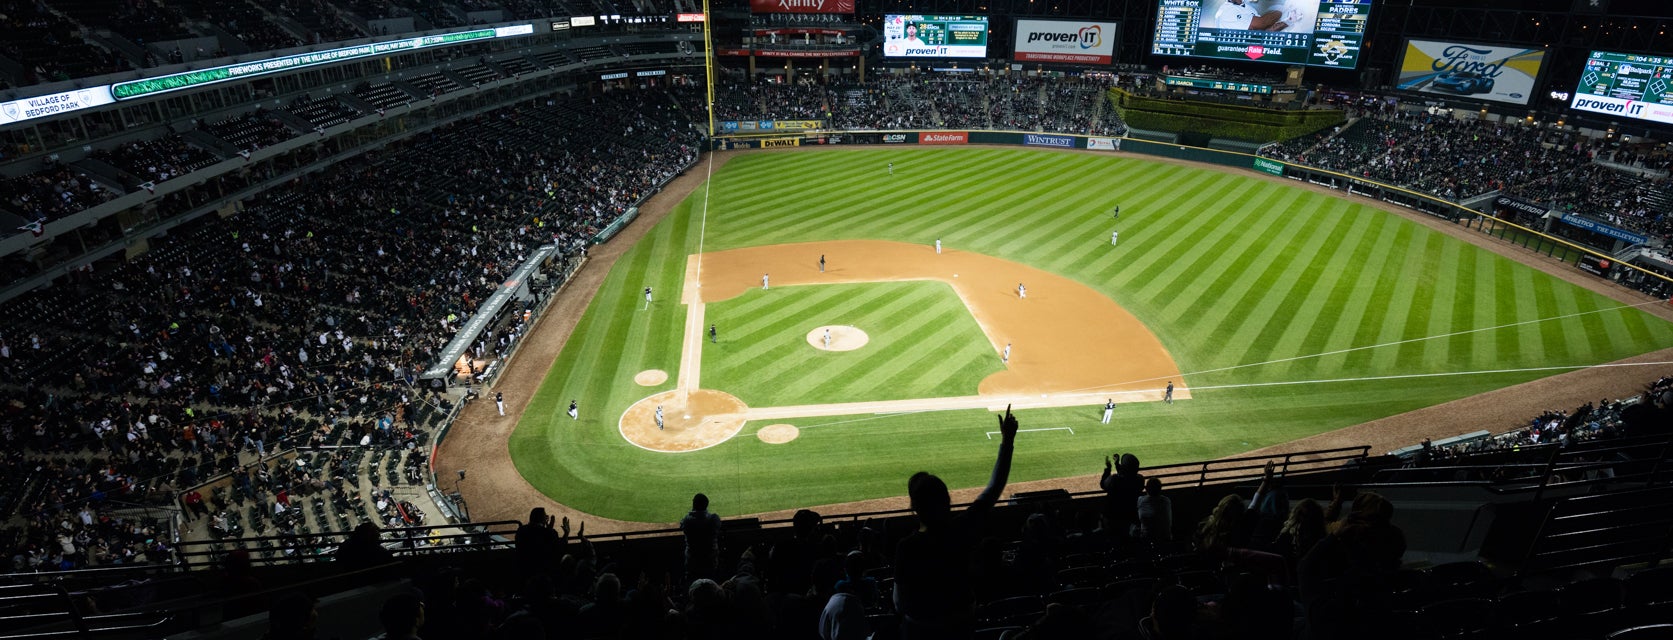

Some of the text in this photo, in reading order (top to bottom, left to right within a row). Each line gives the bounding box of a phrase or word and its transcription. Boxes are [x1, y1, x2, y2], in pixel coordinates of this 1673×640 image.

[1028, 32, 1096, 43] proven IT
[229, 63, 263, 75] FIREWORKS
[263, 59, 293, 70] PRESENTED
[311, 52, 331, 60] VILLAGE
[1432, 45, 1509, 78] Ford
[29, 96, 59, 107] VILLAGE
[1550, 91, 1568, 100] 9:43
[25, 101, 79, 117] BEDFORD PARK
[1575, 99, 1624, 112] proven
[1630, 104, 1644, 114] IT
[1028, 135, 1071, 145] WINTRUST
[1261, 160, 1282, 171] National
[1510, 201, 1544, 215] HYUNDAI
[1564, 215, 1594, 228] ATHLETICO
[1609, 230, 1644, 244] RELIEVERS
